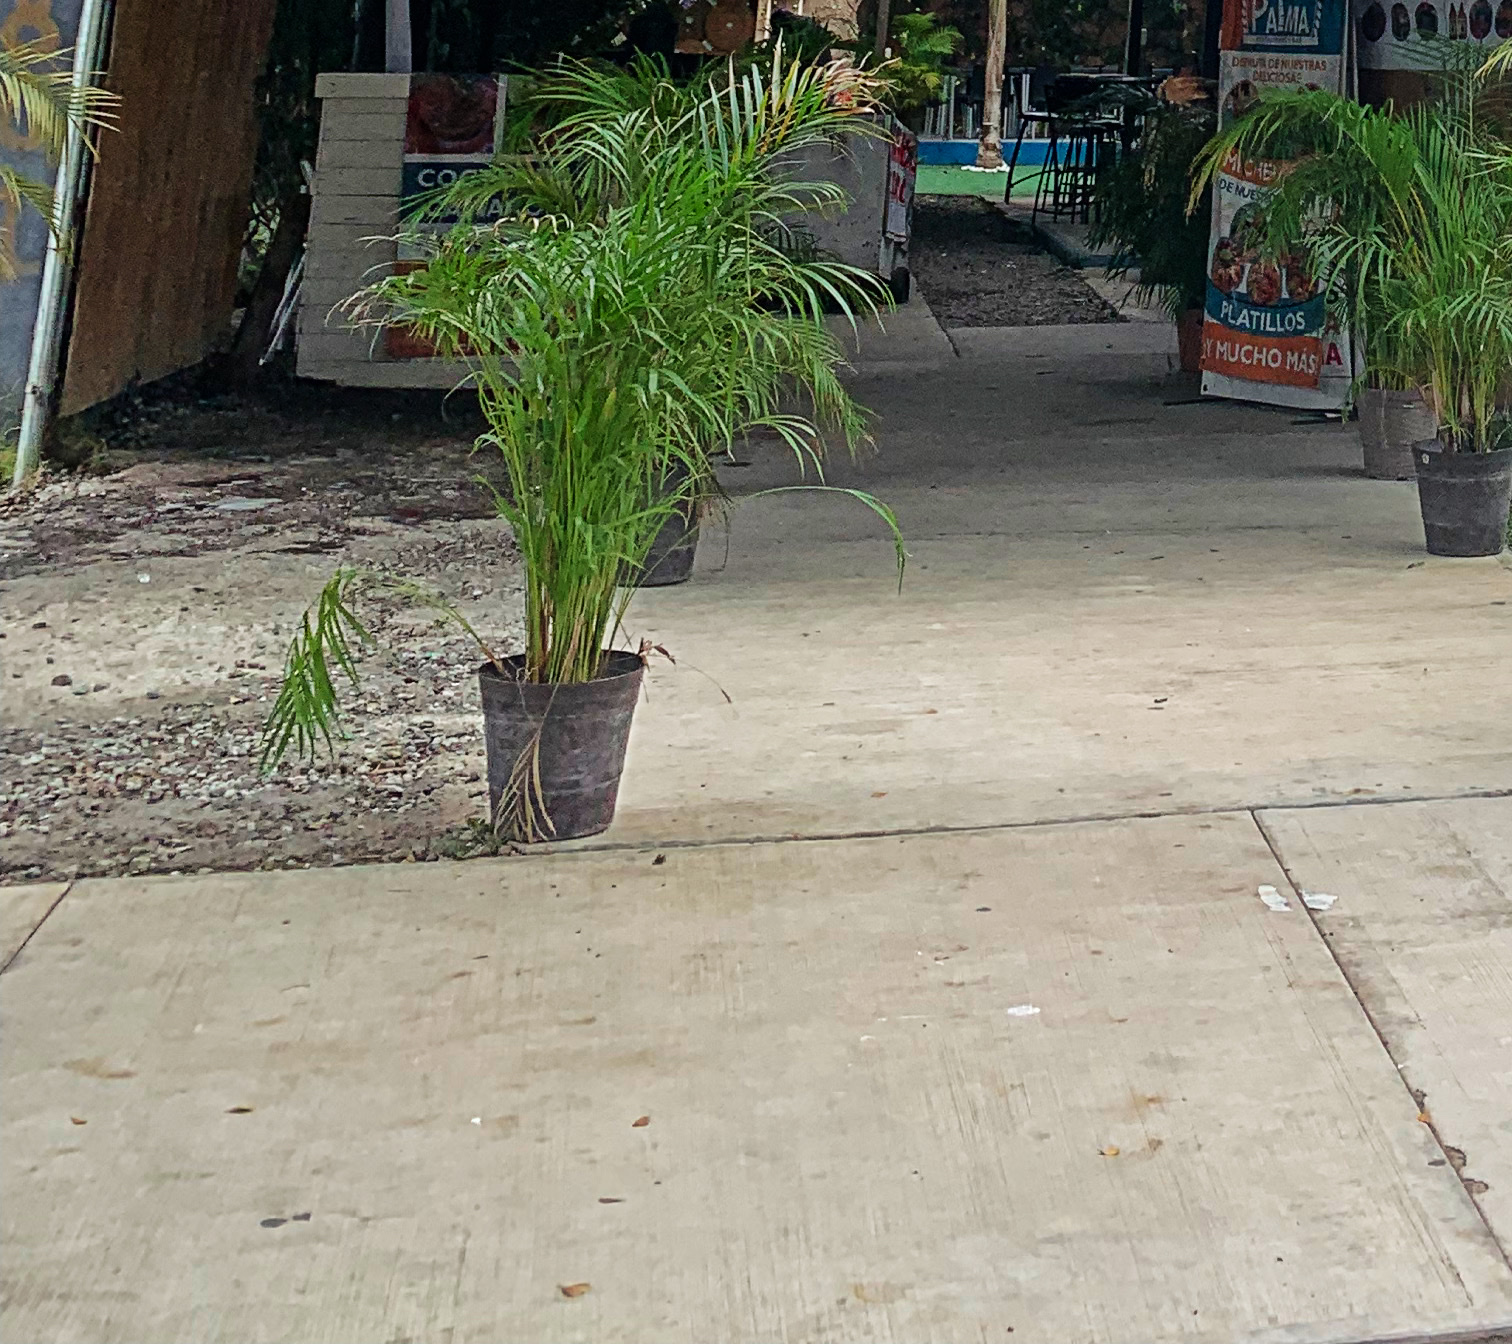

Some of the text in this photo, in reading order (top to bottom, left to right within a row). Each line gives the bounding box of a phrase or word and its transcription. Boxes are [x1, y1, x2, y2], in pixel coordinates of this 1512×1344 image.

[1281, 58, 1327, 71] NUESTRAS
[1218, 178, 1235, 194] DE
[1220, 300, 1306, 332] PLATILLOS
[1215, 340, 1283, 368] MUCHO
